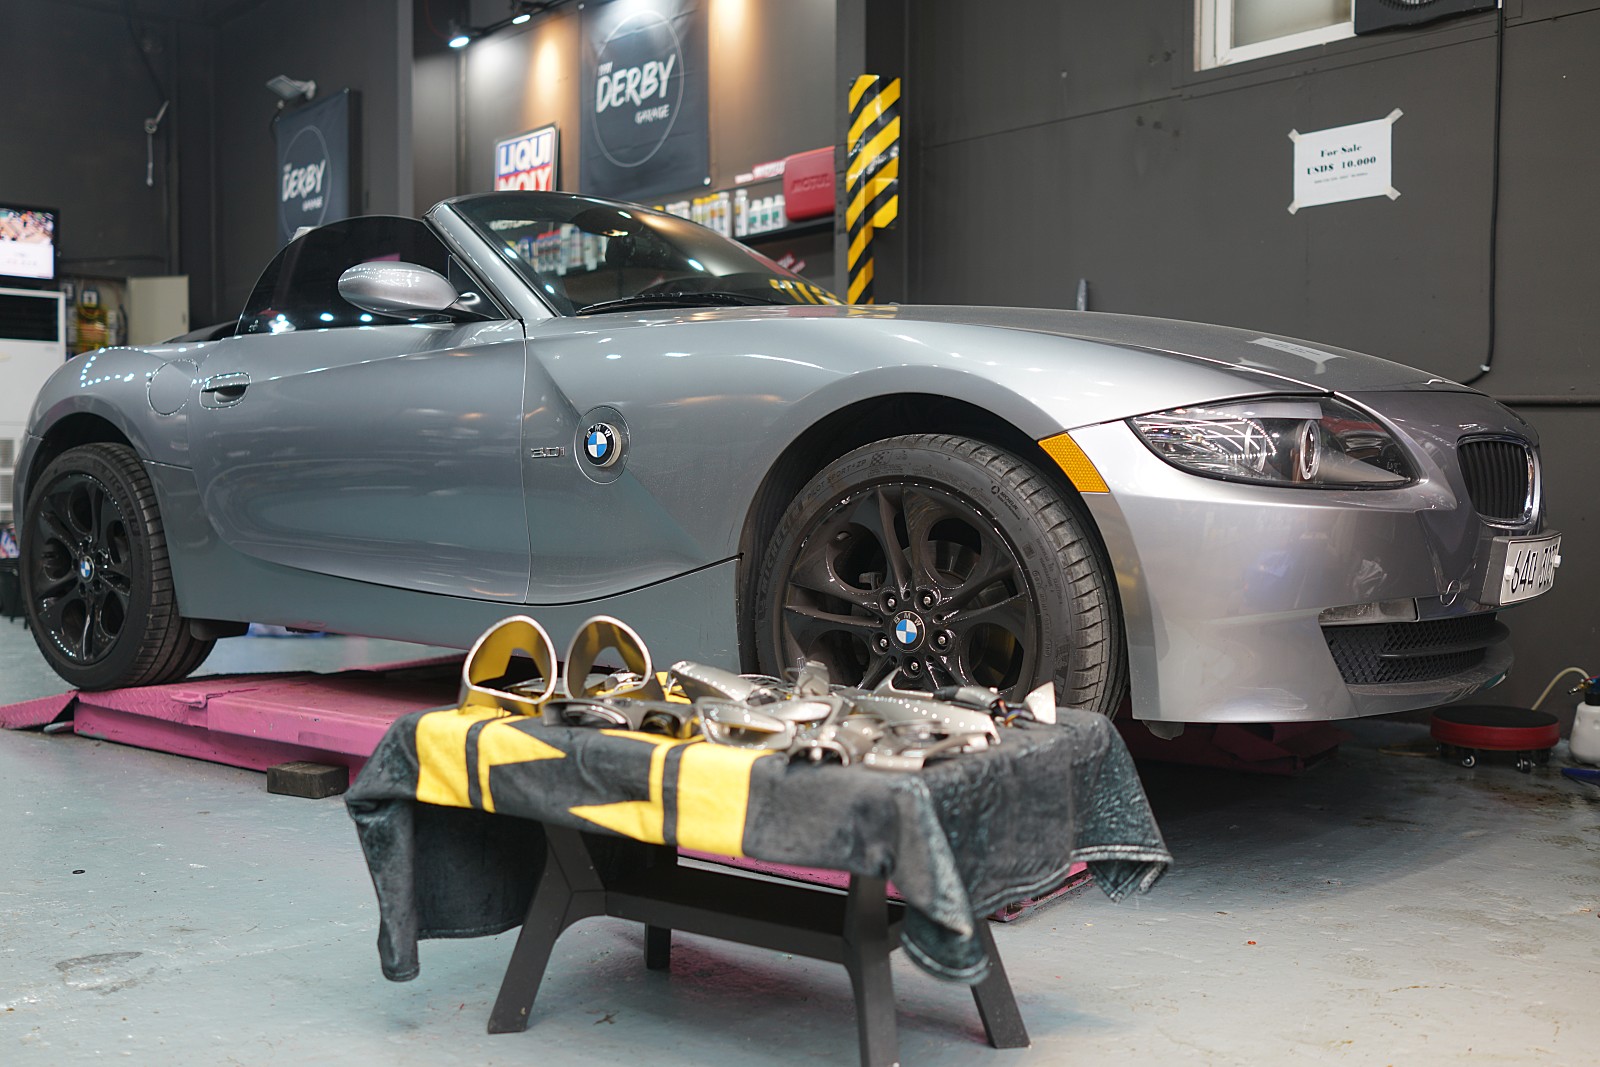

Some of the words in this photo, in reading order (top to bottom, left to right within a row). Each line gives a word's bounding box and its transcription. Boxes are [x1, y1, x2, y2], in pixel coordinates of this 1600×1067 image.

[596, 53, 676, 113] DERBY
[499, 131, 552, 176] LIQUI
[1341, 144, 1362, 153] Sale
[282, 159, 326, 202] DERBY
